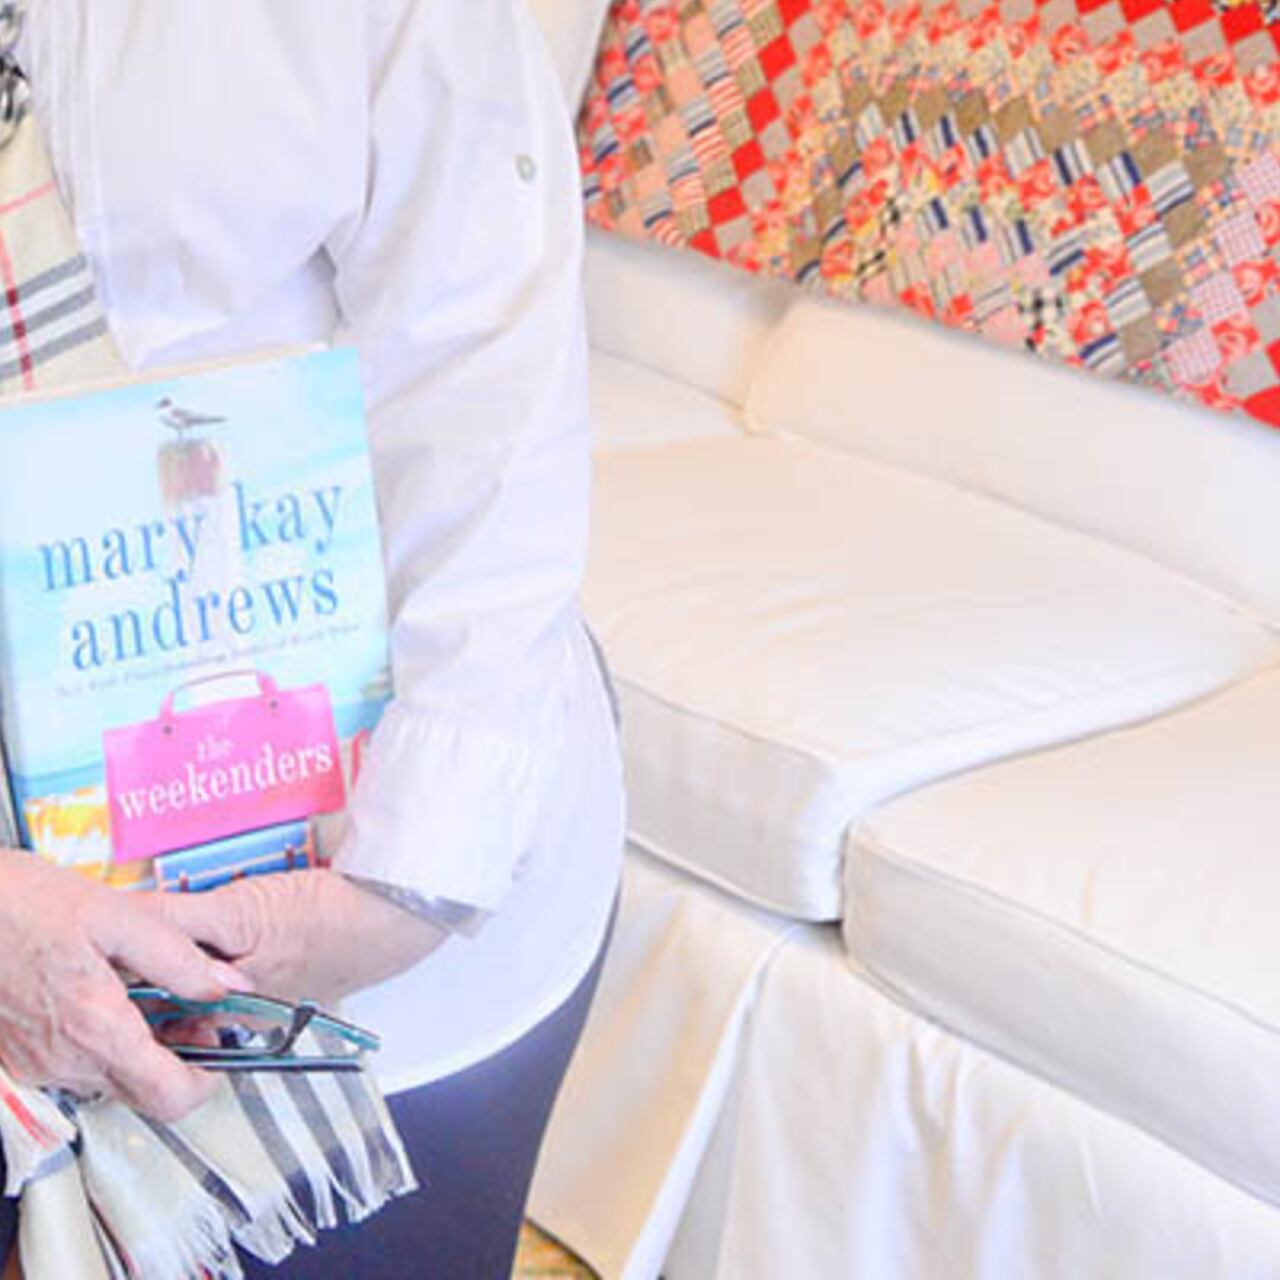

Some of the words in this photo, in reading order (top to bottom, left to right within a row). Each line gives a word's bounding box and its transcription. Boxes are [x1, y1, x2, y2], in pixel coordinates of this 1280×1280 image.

[39, 507, 206, 593] mary
[231, 481, 343, 554] kay
[71, 566, 339, 671] andrews
[116, 741, 333, 820] weekenders
[197, 732, 234, 763] the
